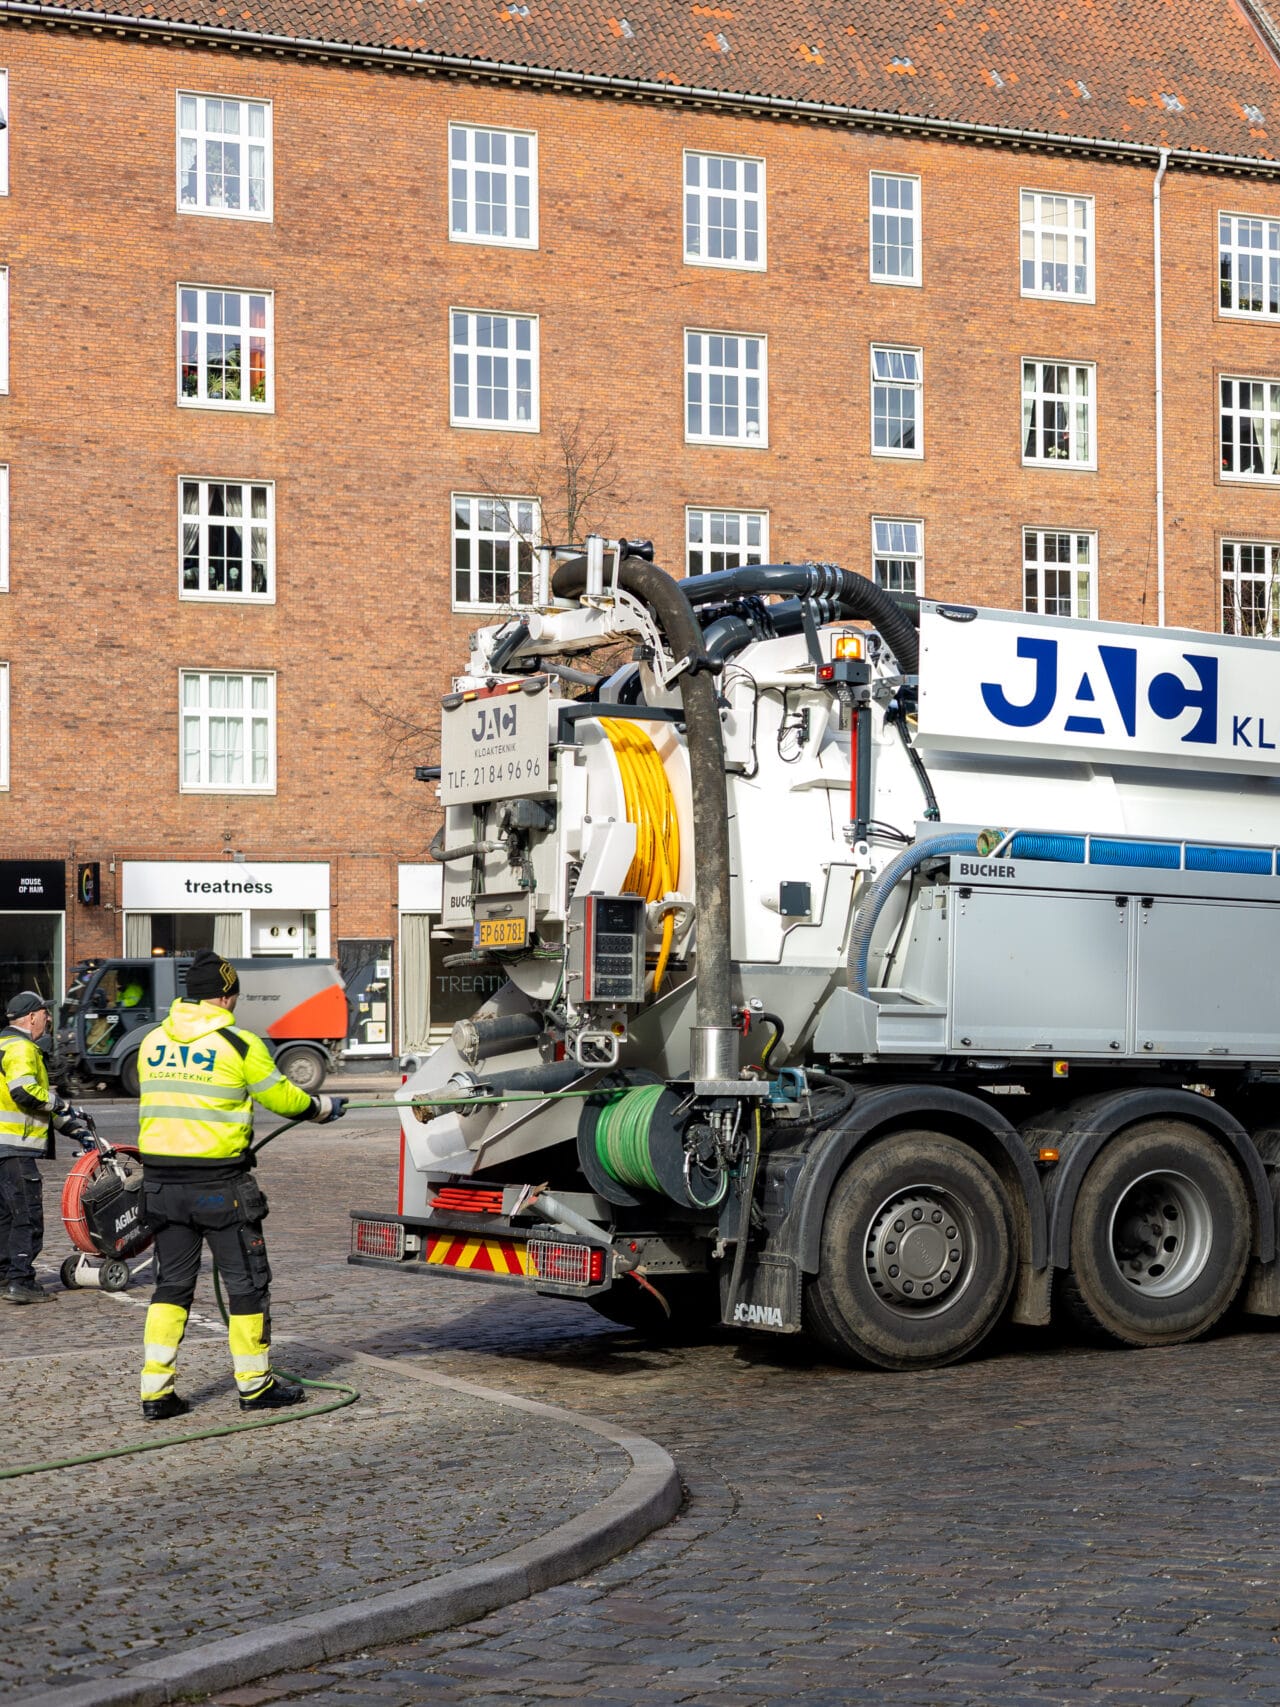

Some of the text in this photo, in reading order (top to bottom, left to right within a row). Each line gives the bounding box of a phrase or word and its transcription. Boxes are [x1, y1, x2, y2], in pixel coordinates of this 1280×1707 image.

[980, 636, 1218, 744] JAC
[472, 704, 517, 742] JAC
[474, 743, 517, 758] KLOAKTEKNIK
[448, 757, 540, 789] TLF. 21 84 96 96
[960, 863, 1016, 878] BUCHER
[20, 878, 42, 886] HOUSE
[185, 879, 273, 893] treatness
[18, 886, 28, 894] OF
[450, 895, 472, 908] BUCH
[480, 921, 522, 942] EP 68 781
[435, 975, 509, 992] TREATN
[147, 1045, 216, 1072] JAC
[149, 1071, 213, 1083] KLOAKTEKNIK
